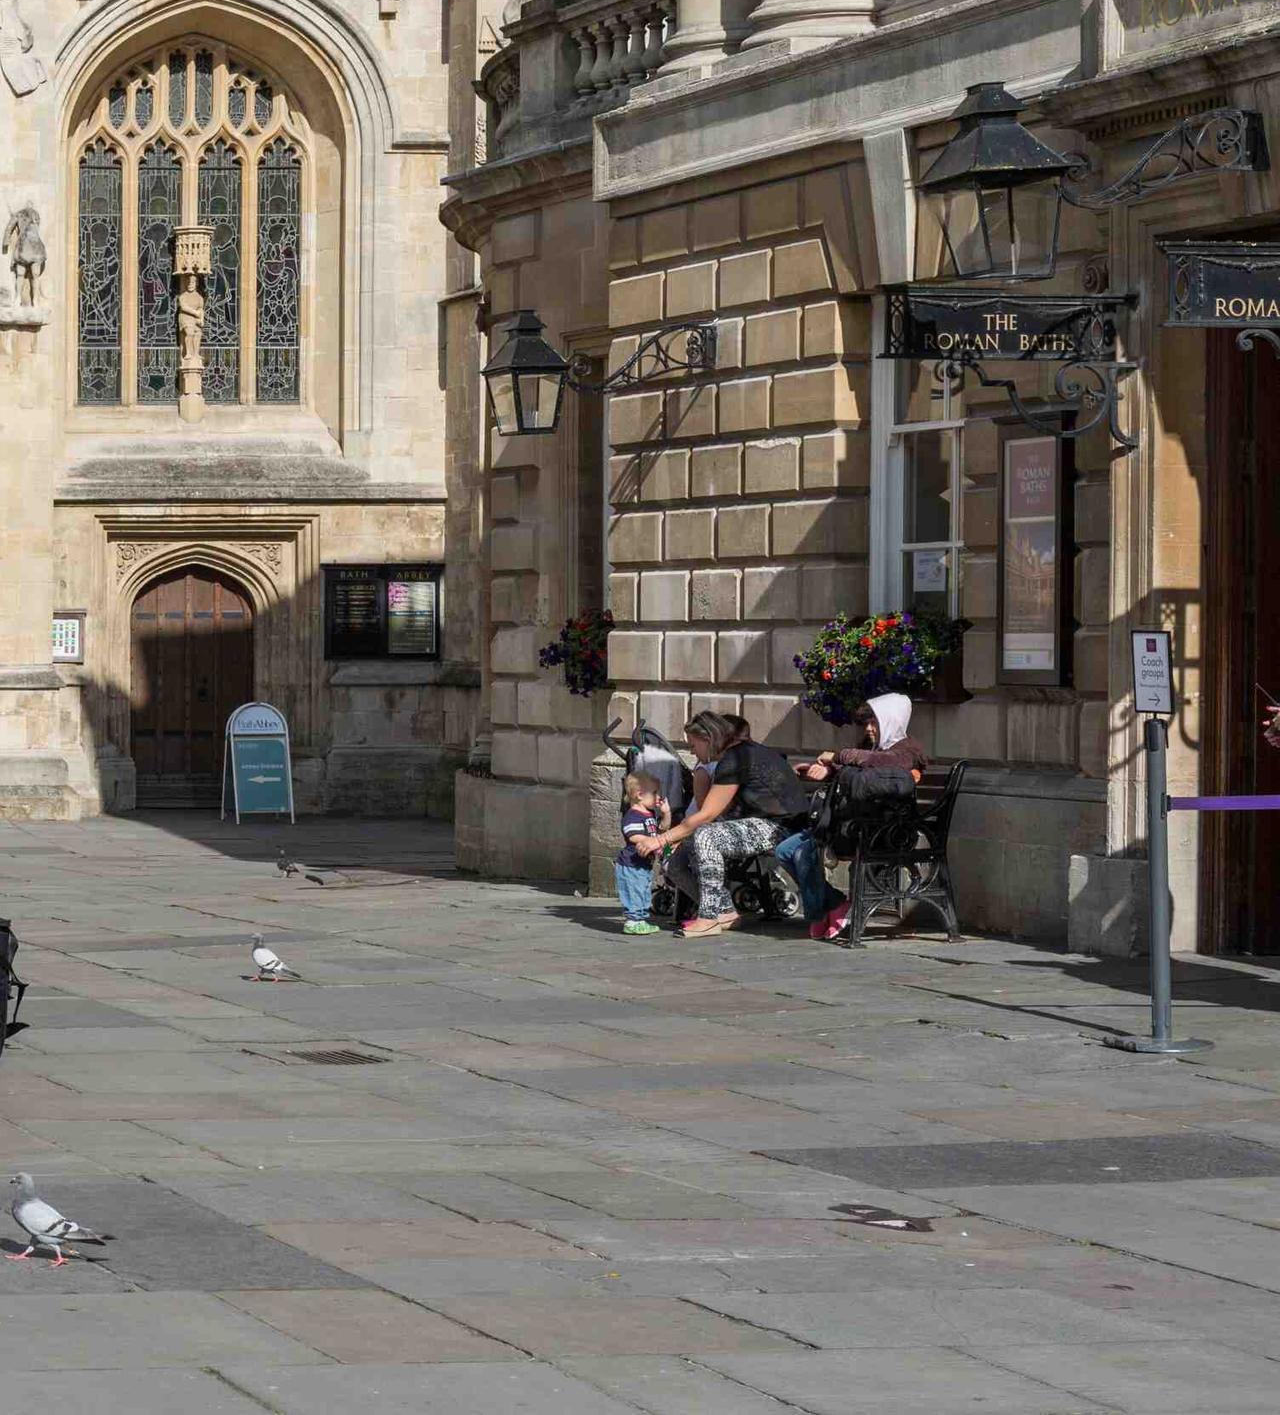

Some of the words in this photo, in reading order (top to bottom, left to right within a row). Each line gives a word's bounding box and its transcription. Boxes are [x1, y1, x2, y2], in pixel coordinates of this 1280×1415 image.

[1215, 297, 1280, 318] ROMA
[983, 313, 1018, 331] THE
[924, 333, 1000, 351] ROMAN
[1019, 333, 1076, 352] BATHS
[340, 570, 369, 579] BATH
[396, 571, 431, 580] ABBEY
[1141, 655, 1164, 667] Coach
[1141, 670, 1165, 681] groups
